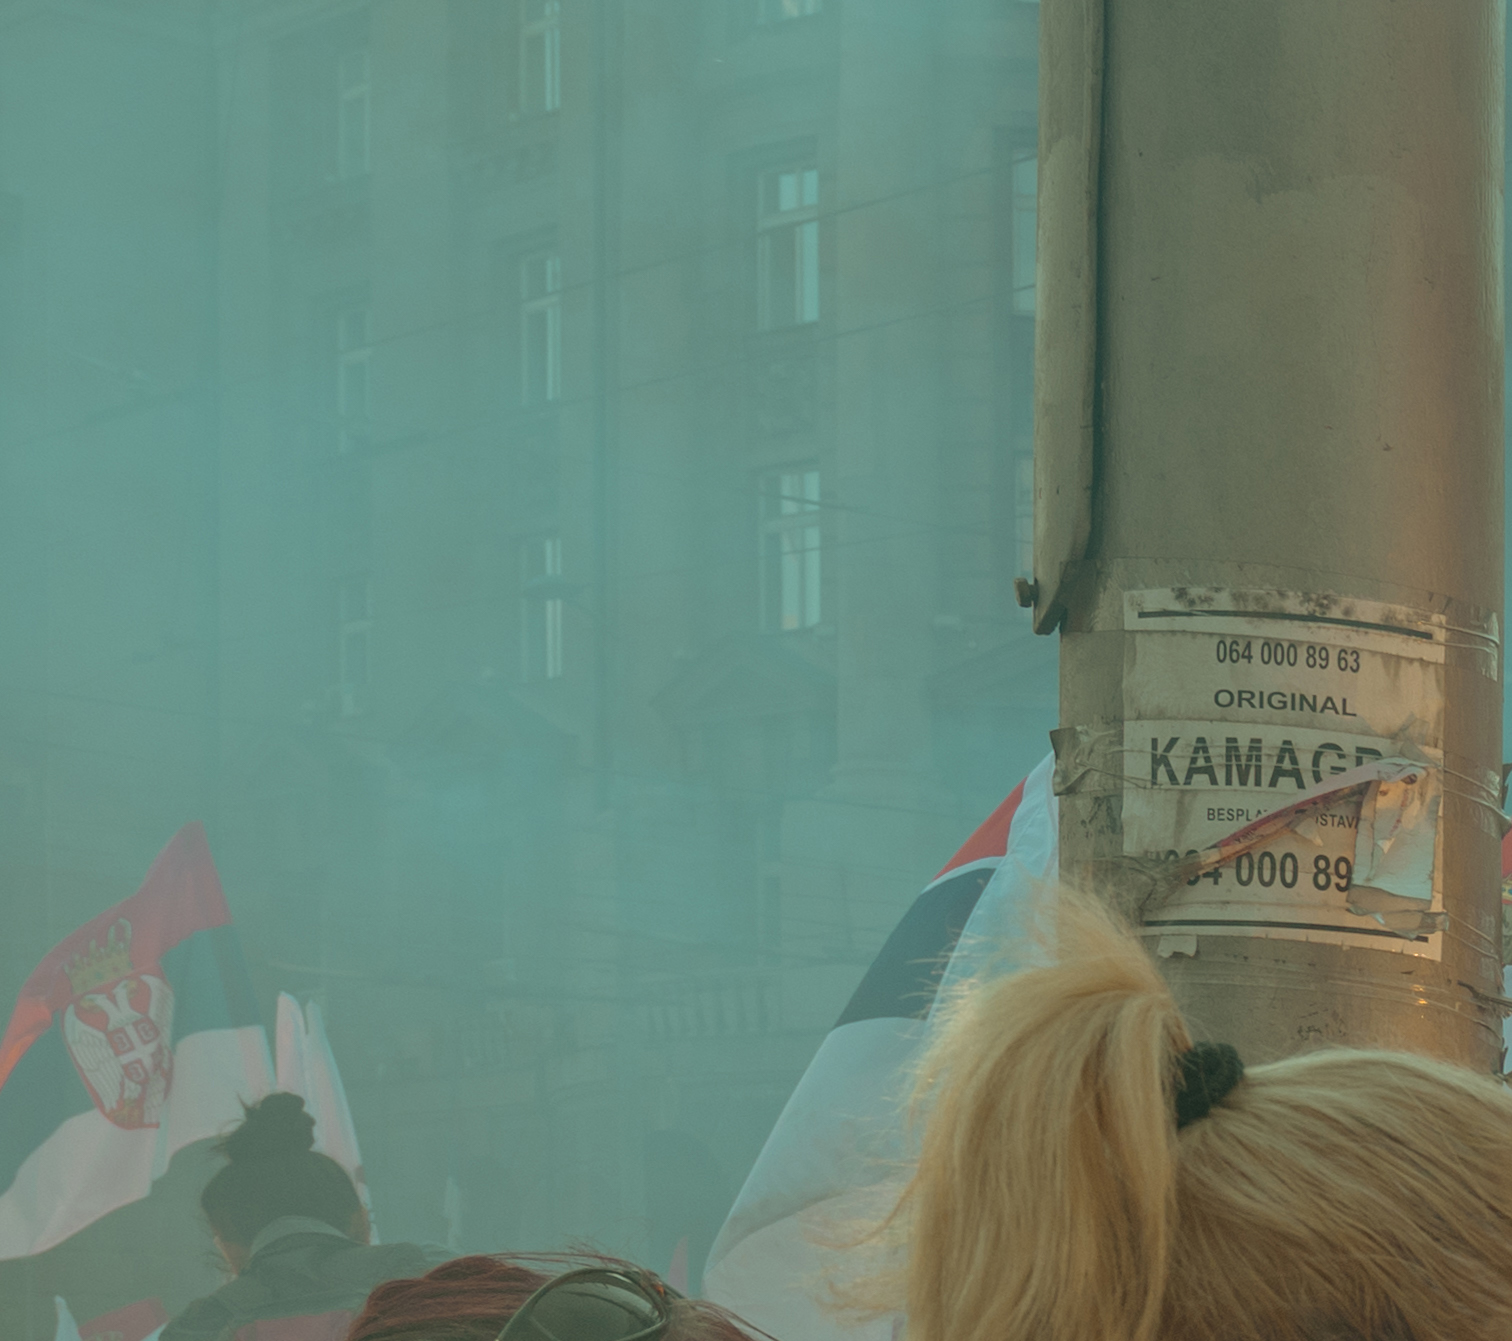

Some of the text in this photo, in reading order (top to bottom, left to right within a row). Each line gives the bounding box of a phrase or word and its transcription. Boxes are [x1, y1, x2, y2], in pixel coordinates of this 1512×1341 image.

[1215, 639, 1360, 673] 064 000 89 63
[1213, 689, 1357, 717] ORIGINAL
[1206, 807, 1268, 822] BESPL
[1235, 851, 1299, 888] 000
[1312, 854, 1351, 892] 89
